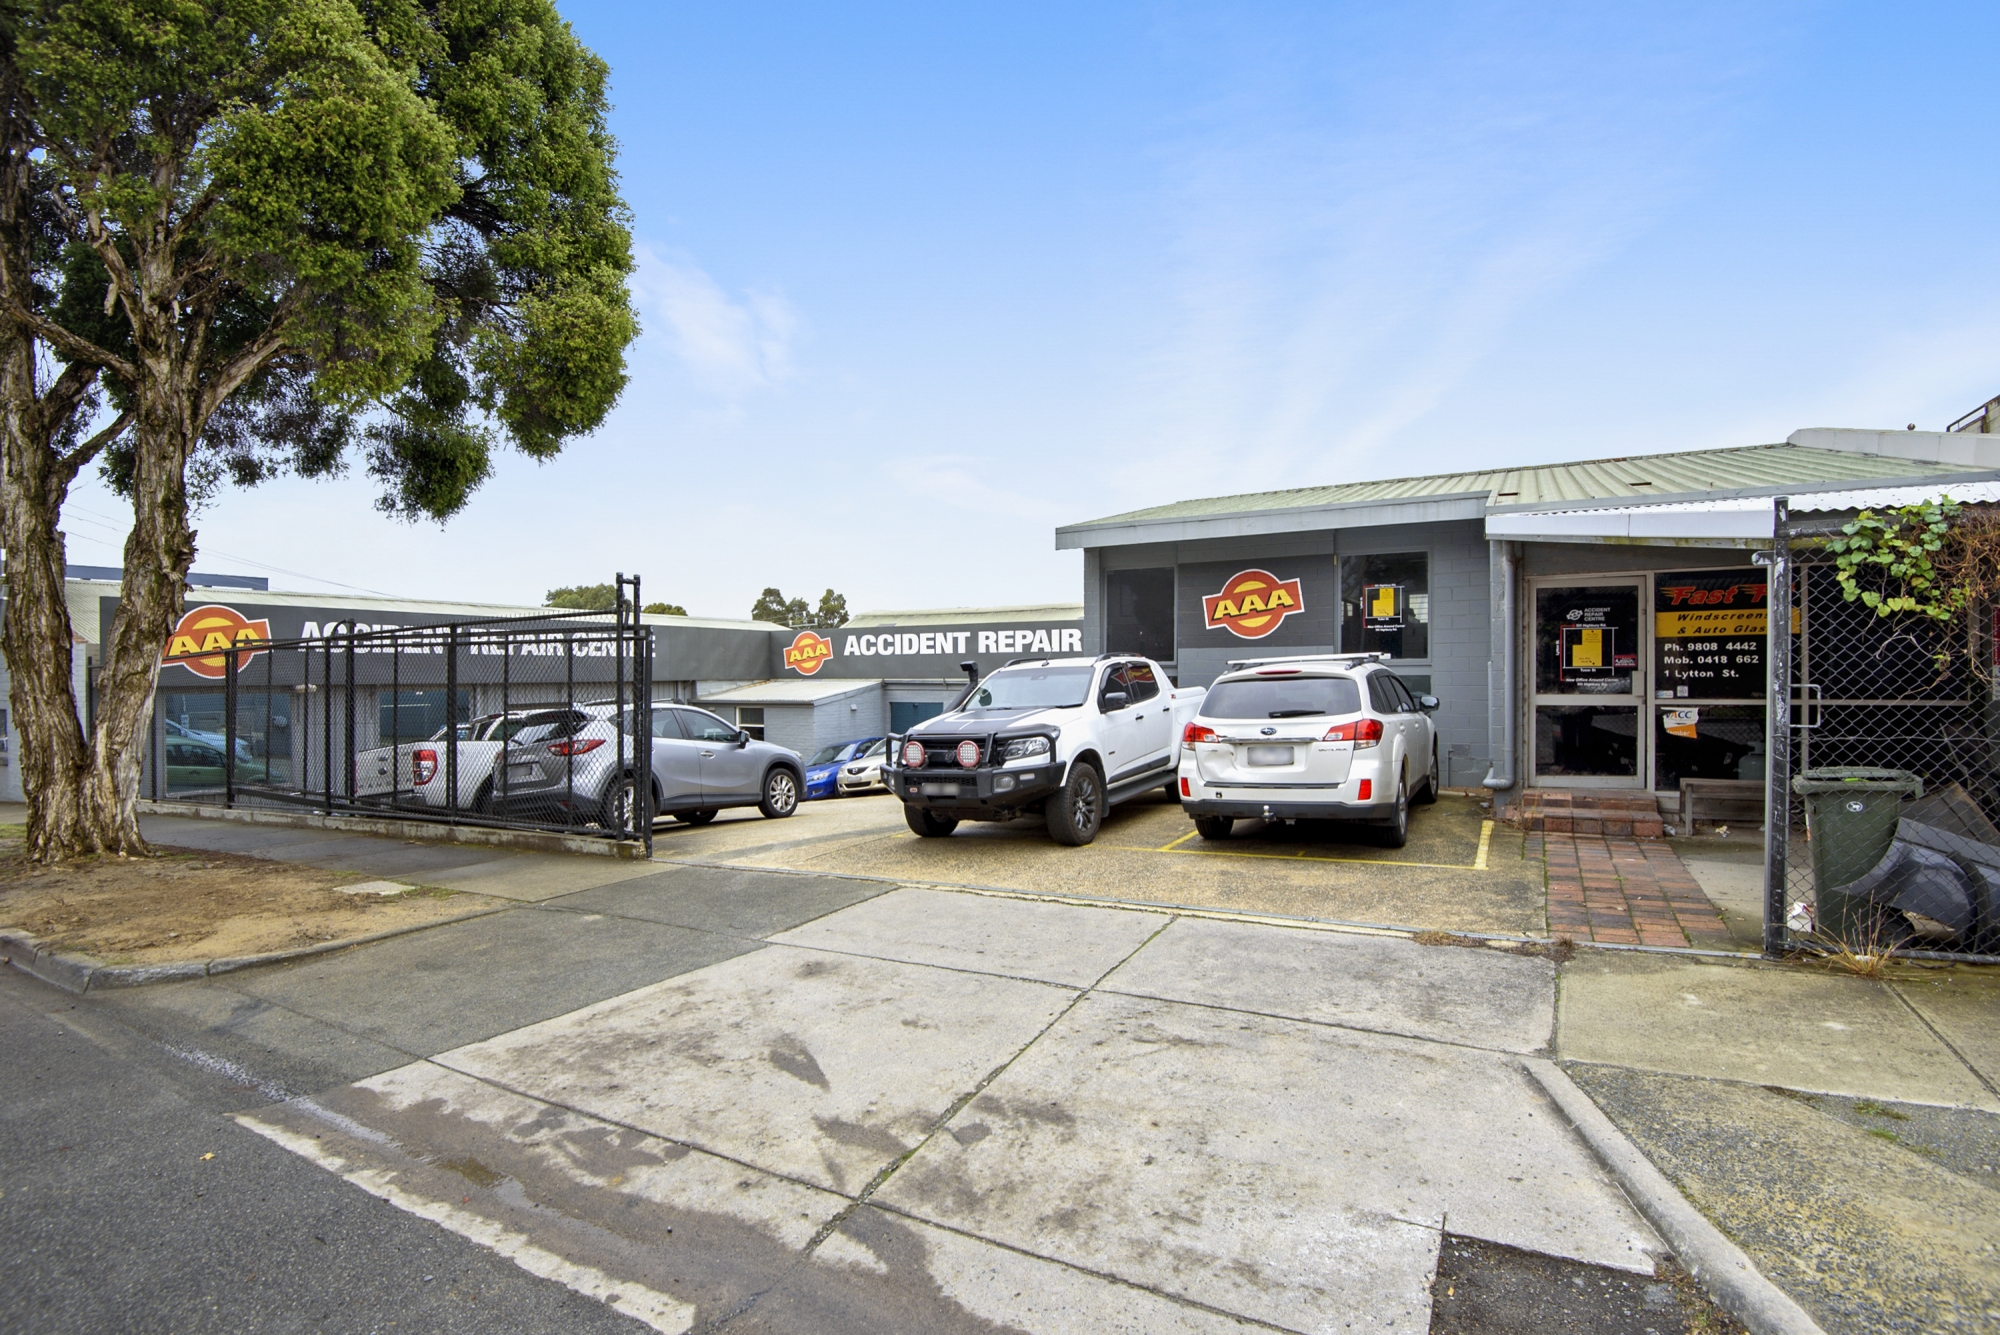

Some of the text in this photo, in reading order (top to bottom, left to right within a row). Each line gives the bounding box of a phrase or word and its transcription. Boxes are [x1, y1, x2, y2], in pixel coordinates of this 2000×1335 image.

[1211, 588, 1295, 621] AAA
[1661, 584, 1739, 605] Fast
[1677, 625, 1767, 635] & Auto Glas
[167, 628, 263, 657] AAA
[470, 628, 565, 657] REPAIR
[788, 628, 1083, 664] AAA ACCIDENT REPAIR
[1664, 642, 1757, 651] Ph. 9808 4442
[1664, 655, 1760, 664] Mob. 0418 662
[1675, 669, 1714, 679] Lytton
[1721, 669, 1739, 677] St.
